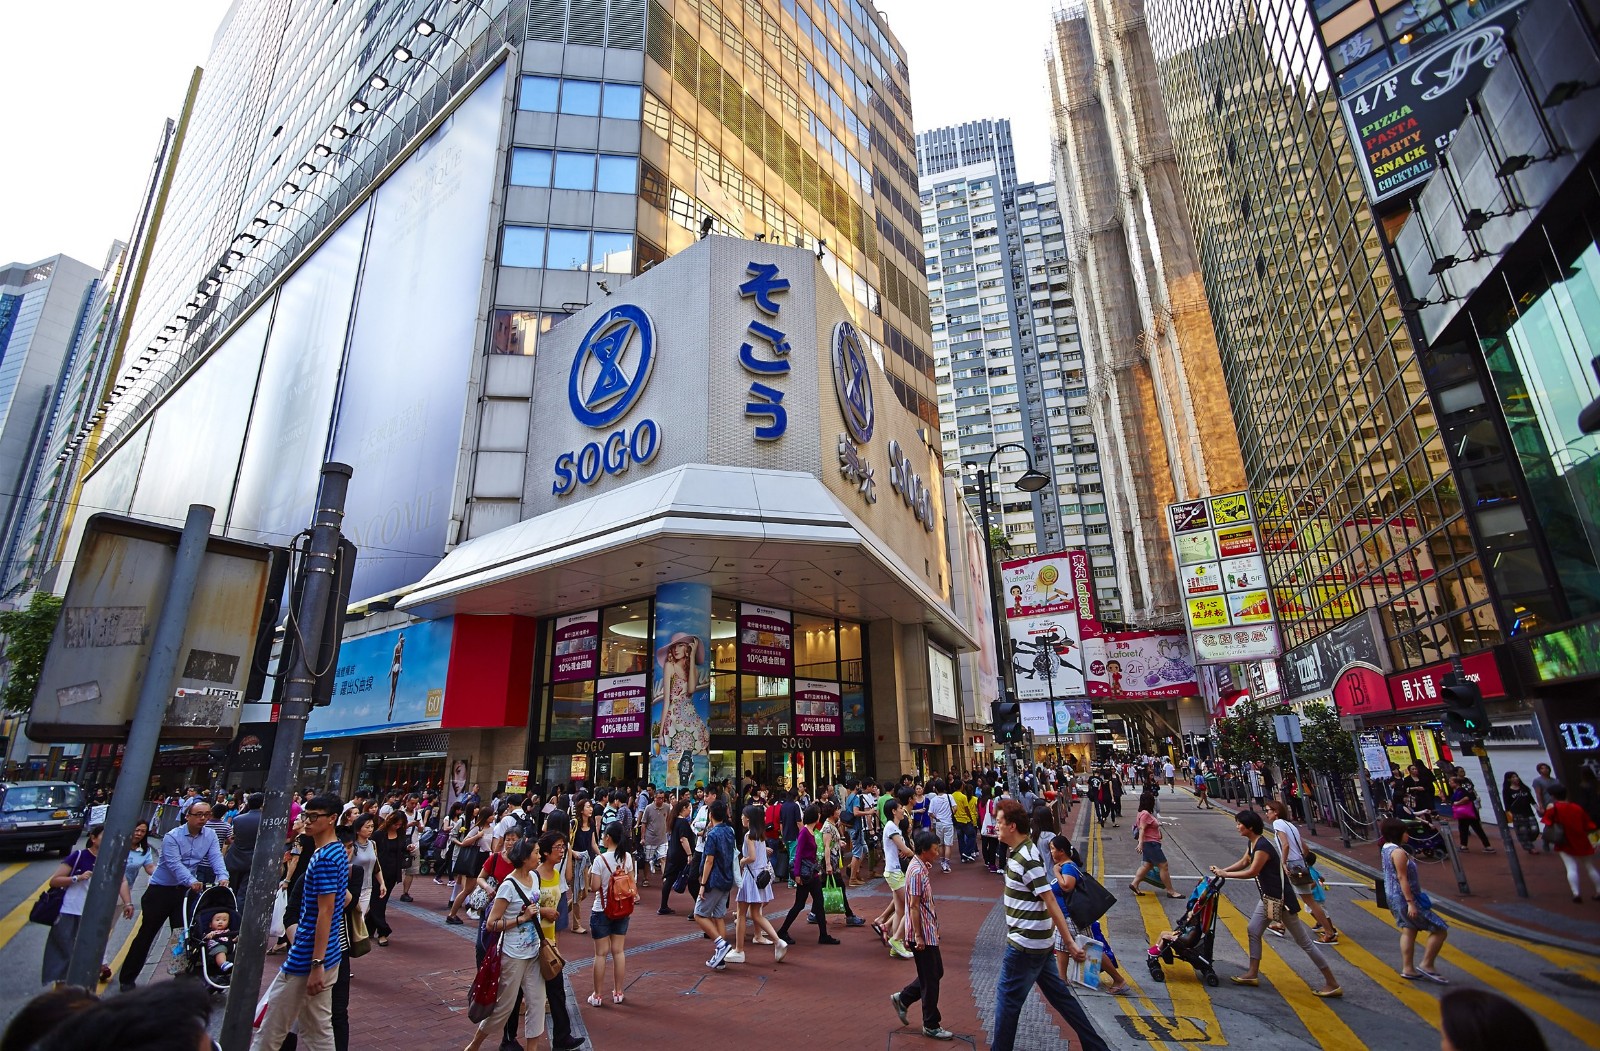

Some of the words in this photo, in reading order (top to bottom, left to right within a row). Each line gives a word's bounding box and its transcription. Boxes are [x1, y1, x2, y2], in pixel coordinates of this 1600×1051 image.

[1355, 76, 1398, 115] 4/F
[1361, 105, 1413, 137] PIZZA
[1366, 118, 1418, 150] PASTA
[1370, 130, 1421, 164] PARTY
[1374, 144, 1427, 178] SNACK
[1378, 159, 1432, 191] COCKTAIL
[738, 261, 791, 441] そごう
[553, 419, 661, 496] SOGO
[888, 440, 934, 533] SOGO
[1076, 579, 1093, 620] Laforet
[1109, 650, 1138, 659] Laforet
[427, 695, 440, 712] 60
[1401, 674, 1437, 702] 周大福
[576, 740, 606, 753] SOGO
[782, 737, 811, 749] SOGO
